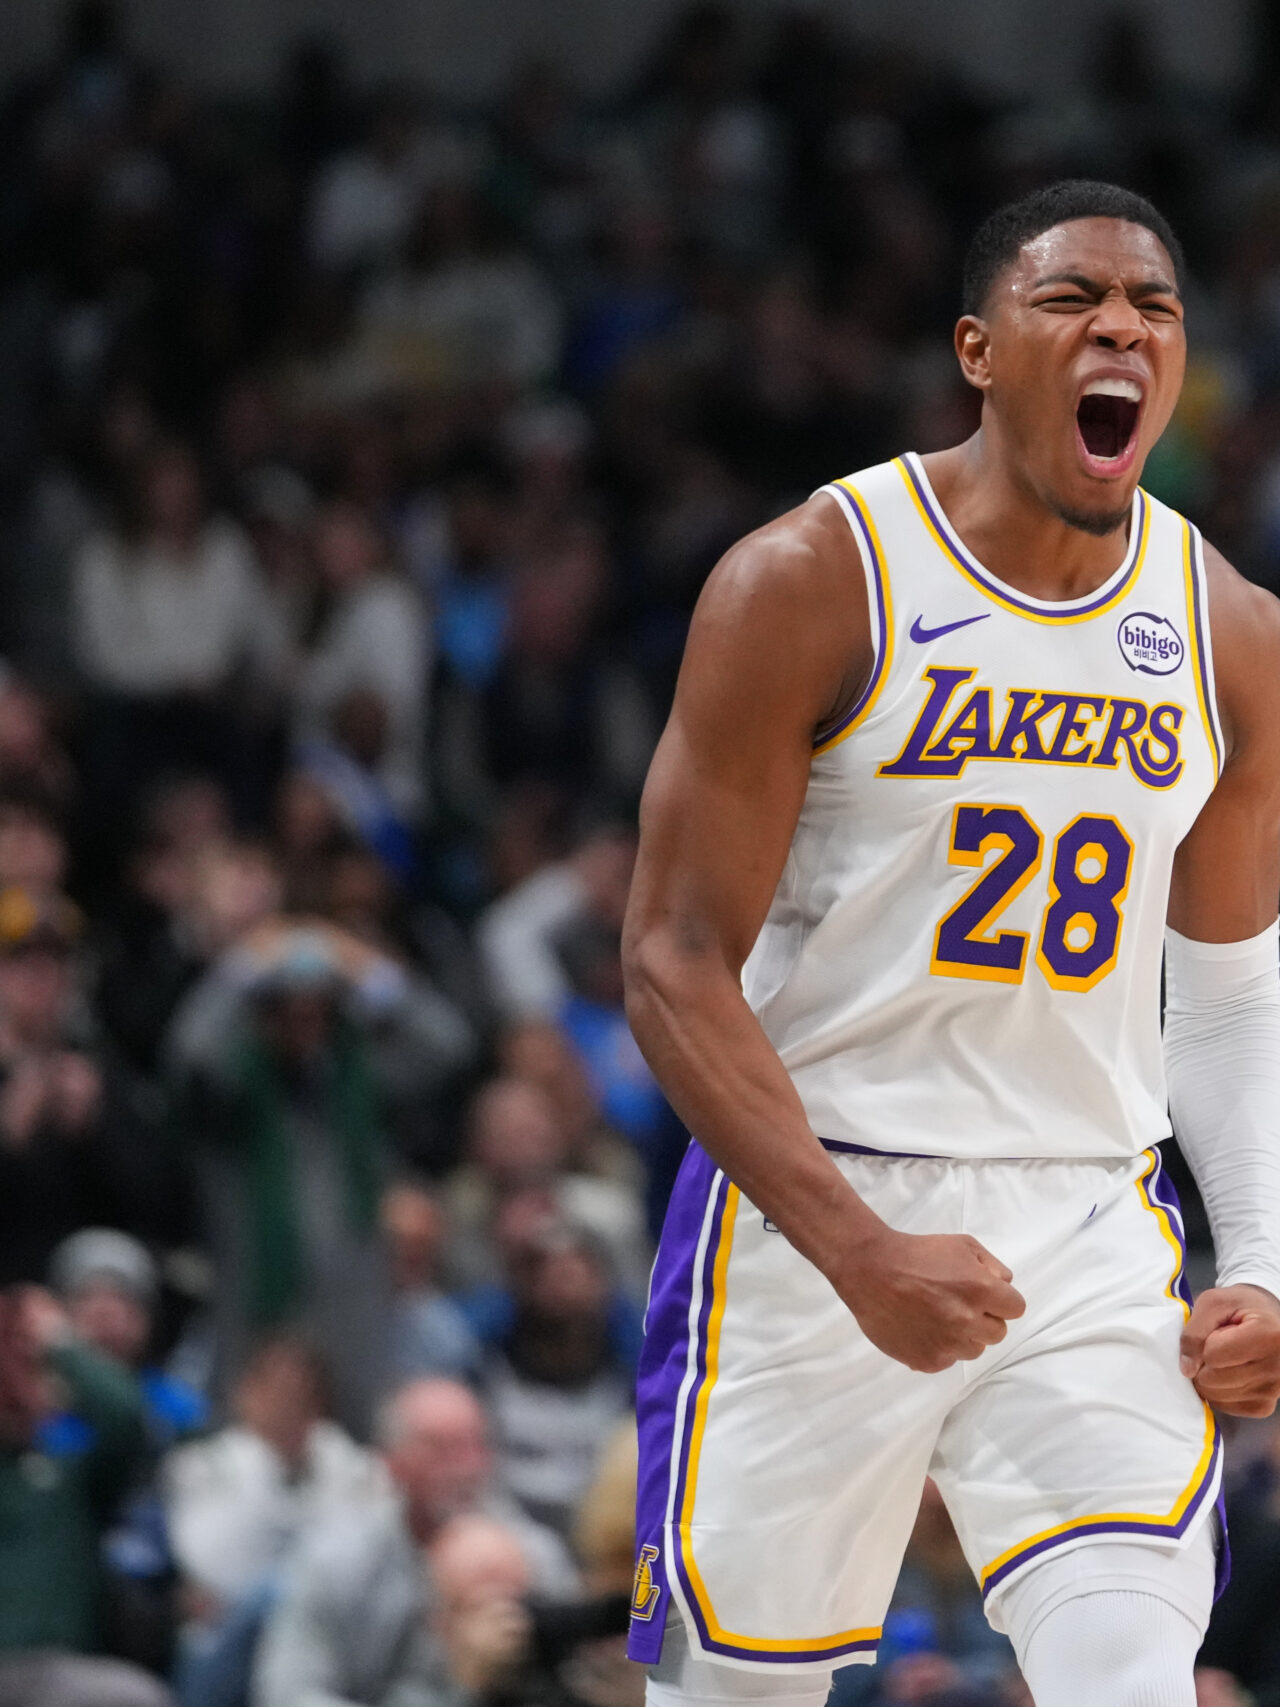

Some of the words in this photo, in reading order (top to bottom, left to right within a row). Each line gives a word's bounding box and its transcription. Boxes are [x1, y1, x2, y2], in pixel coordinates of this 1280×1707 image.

[1124, 625, 1180, 660] bibigo
[1133, 648, 1158, 662] 비비고
[875, 665, 1185, 791] LAKERS
[930, 803, 1135, 993] 28
